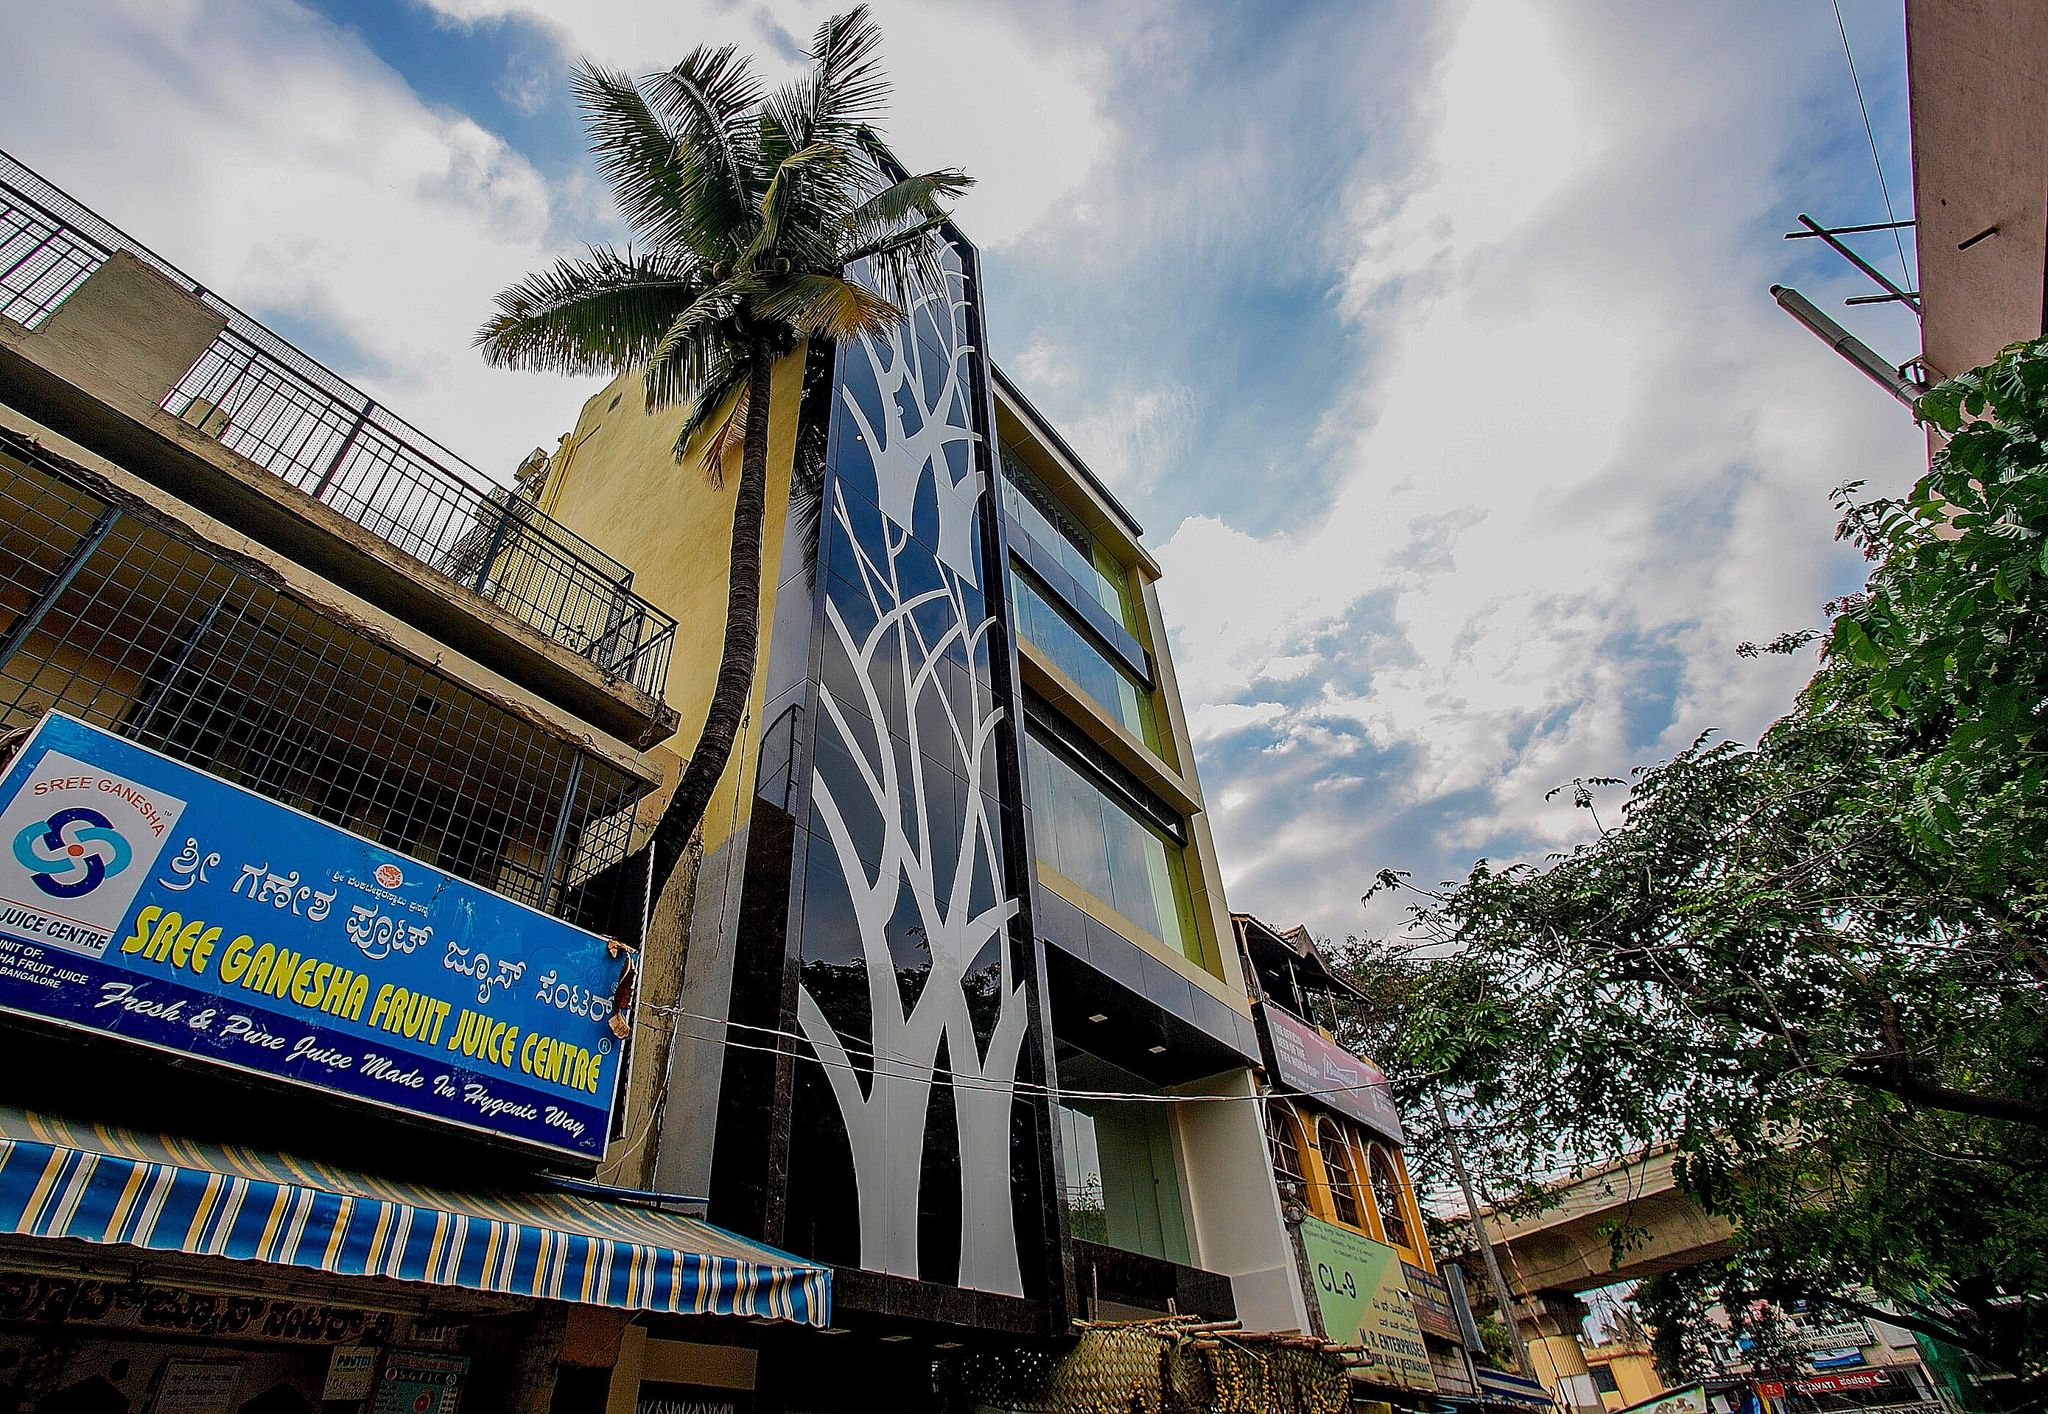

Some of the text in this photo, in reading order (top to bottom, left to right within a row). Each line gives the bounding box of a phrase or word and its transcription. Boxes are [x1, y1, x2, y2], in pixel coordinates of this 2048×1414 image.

[34, 776, 93, 796] SREE
[97, 778, 167, 838] GANESHA
[0, 907, 108, 951] JUICE CENTRE
[159, 837, 221, 891] ಶ್ರೀ
[232, 862, 338, 922] ಗಣೇಶ
[443, 942, 527, 1004] ಜ್ಯೂಸ್
[536, 970, 615, 1022] ಸೆಂಟರ್
[16, 957, 54, 975] FRUIT
[53, 968, 89, 985] JUICE
[24, 946, 45, 960] OF:
[0, 966, 62, 989] BANGALORE
[120, 905, 223, 975] SREE
[220, 934, 369, 1022] GANESHA
[368, 983, 452, 1046] FRUIT
[447, 1008, 520, 1064] JUICE
[520, 1032, 603, 1095] CENTRE
[95, 981, 586, 1138] Fresh & Pure Juice Made In Hygenic Way
[1317, 1262, 1357, 1300] CL-9
[1378, 1333, 1427, 1360] ENTERPRISES
